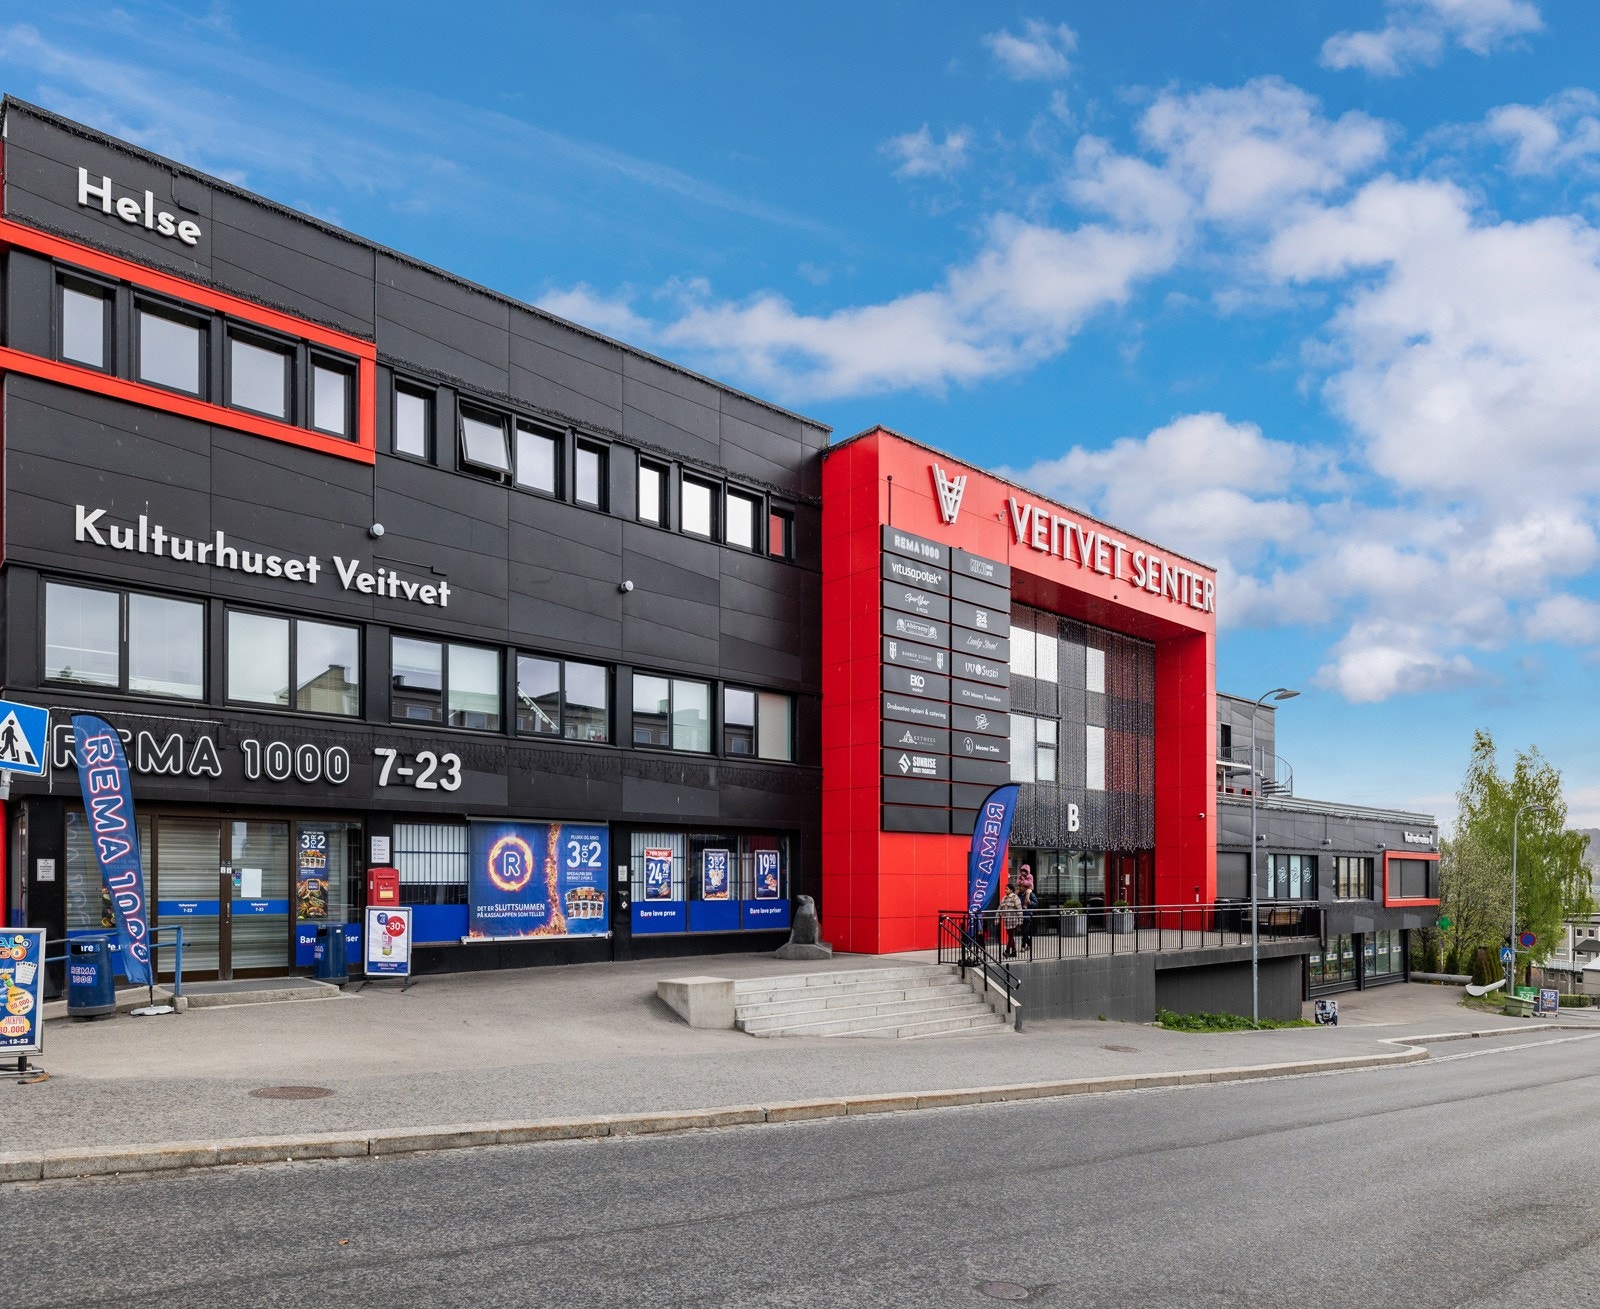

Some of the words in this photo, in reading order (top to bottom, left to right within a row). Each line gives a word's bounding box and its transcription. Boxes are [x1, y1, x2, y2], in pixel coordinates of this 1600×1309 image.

[78, 166, 201, 246] Helse
[74, 504, 321, 584] Kulturhuset
[333, 555, 451, 607] Veitvet
[894, 534, 920, 554] REMA
[921, 543, 940, 560] 1000
[1009, 497, 1130, 579] VEITVET
[1131, 550, 1216, 614] SENTER
[976, 614, 988, 624] 24
[910, 674, 925, 688] EKO
[241, 738, 350, 785] 1000
[374, 747, 463, 792] 7-23
[912, 756, 936, 769] SUNRISE
[84, 735, 130, 863] REMA
[1067, 803, 1080, 832] B
[301, 834, 310, 849] 3
[317, 835, 325, 849] 2
[503, 851, 520, 876] R
[567, 841, 581, 868] 3
[588, 841, 601, 867] 2
[708, 856, 715, 869] 3
[719, 856, 725, 869] 2
[759, 854, 769, 875] 19
[769, 854, 776, 865] 90
[648, 863, 662, 884] 24
[495, 903, 545, 911] SLUTTSUMMEN
[769, 907, 782, 915] priser
[387, 922, 405, 931] -30%
[71, 966, 96, 975] REMA
[72, 976, 93, 984] 1000
